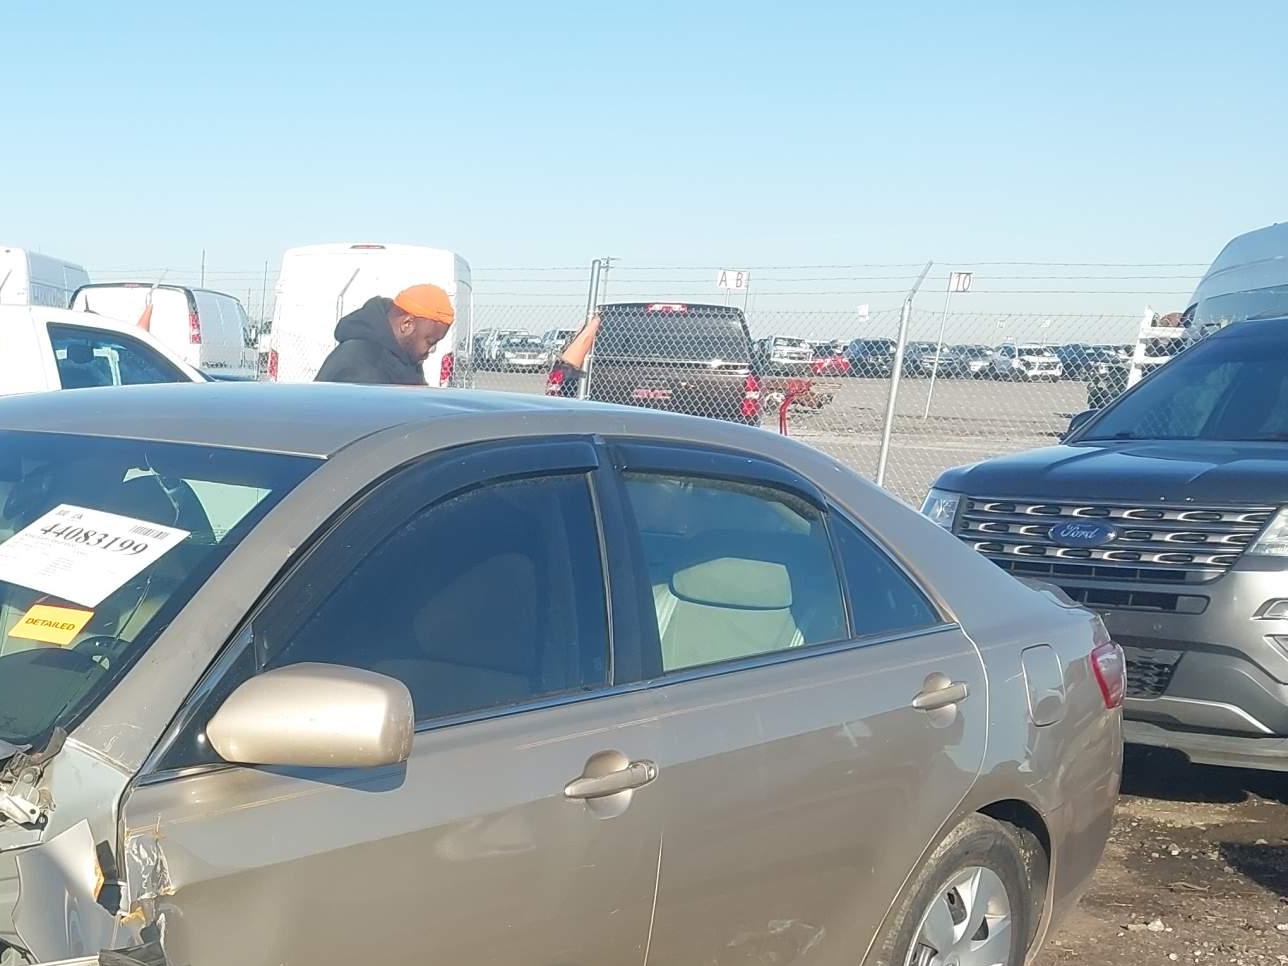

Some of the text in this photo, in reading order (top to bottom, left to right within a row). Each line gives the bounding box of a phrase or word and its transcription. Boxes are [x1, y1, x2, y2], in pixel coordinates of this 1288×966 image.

[718, 271, 744, 288] A B
[954, 272, 972, 292] 10
[40, 522, 149, 556] 44083199
[1060, 523, 1100, 539] Ford
[24, 617, 76, 632] DETAILED
